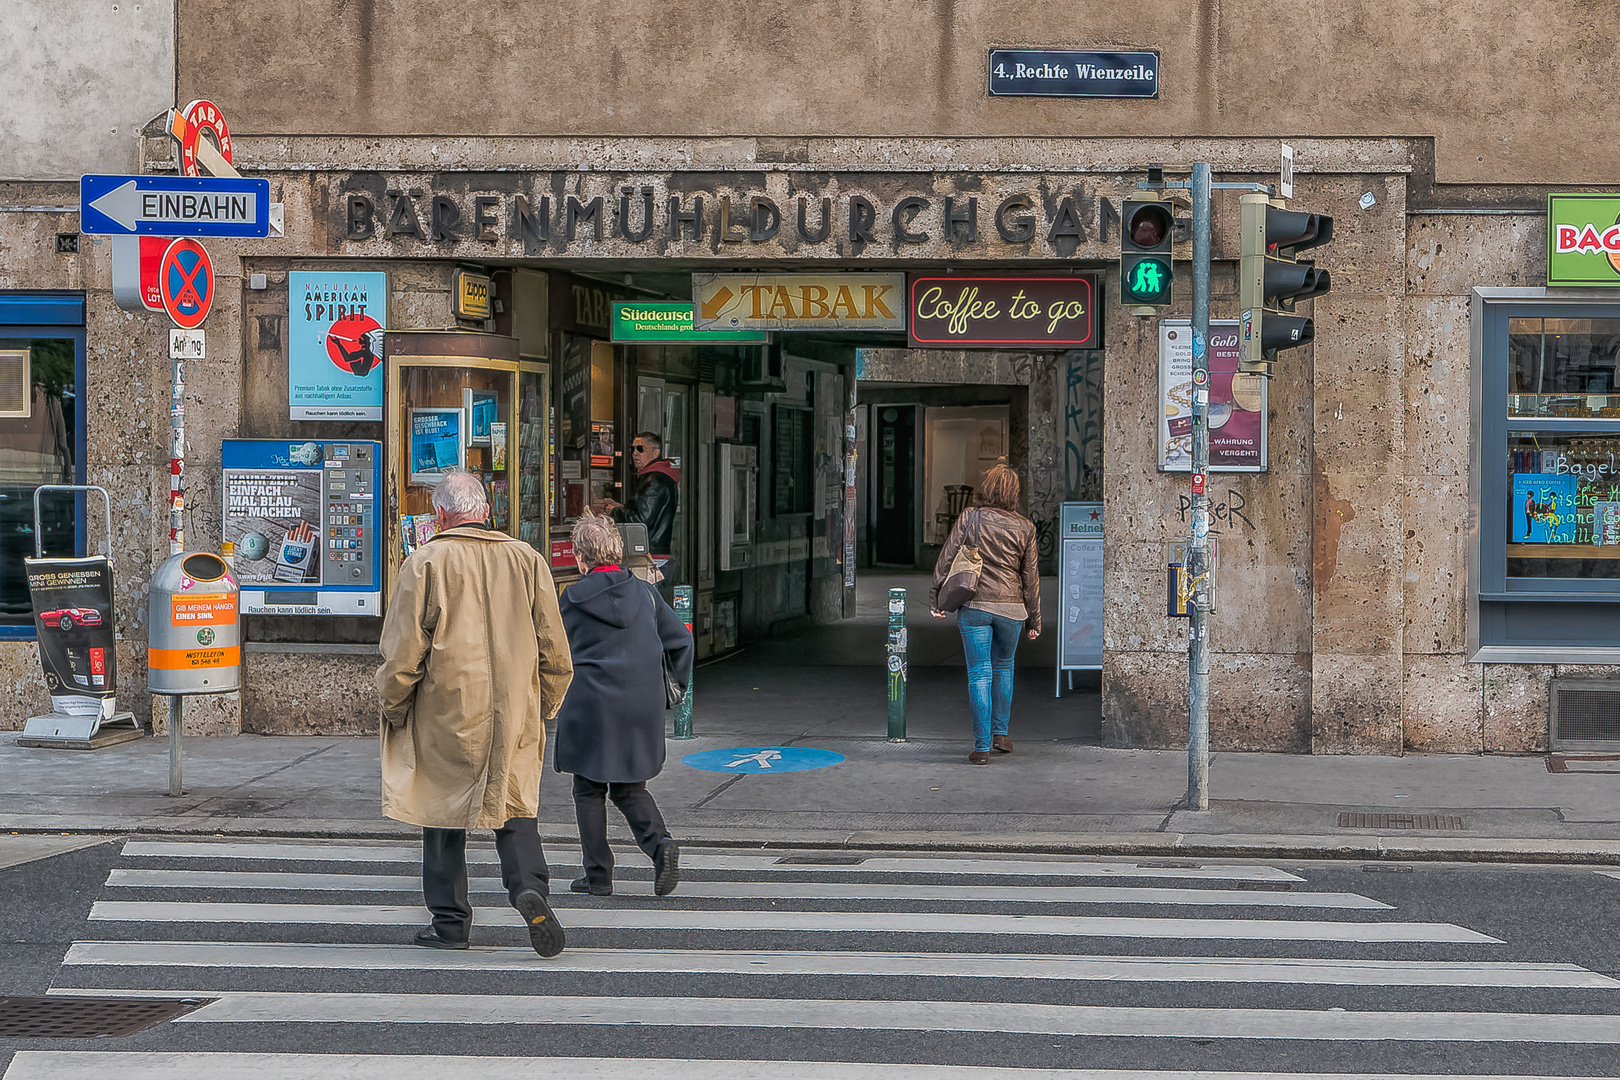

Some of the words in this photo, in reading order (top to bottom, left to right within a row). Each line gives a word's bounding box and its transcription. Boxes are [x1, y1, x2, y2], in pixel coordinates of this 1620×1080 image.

[1075, 63, 1154, 80] Wienzeile
[189, 105, 231, 154] TABAK
[141, 195, 247, 221] EINBAHN
[1559, 226, 1620, 250] BAG
[147, 294, 161, 303] LOT
[304, 292, 367, 302] AMERICAN
[740, 284, 897, 319] TABAK
[572, 284, 624, 328] TABA
[917, 286, 1001, 334] Coffee
[1008, 289, 1042, 319] to
[1047, 300, 1086, 334] go
[304, 303, 367, 321] SPIRIT
[635, 323, 679, 331] Deutschlands
[1210, 334, 1238, 347] Gold
[414, 415, 438, 423] GROSSER
[414, 421, 447, 429] GESCHMACK
[229, 485, 281, 496] EINFACH
[229, 496, 257, 506] MAL
[260, 496, 293, 507] BLAU
[229, 506, 245, 517] ZU
[248, 507, 301, 518] MACHEN
[1070, 523, 1104, 533] Heinek
[28, 573, 56, 581] GROSS
[57, 571, 101, 579] GENIESSEN
[46, 578, 87, 586] GEWINNEN
[175, 604, 186, 612] GIB
[187, 603, 212, 611] MEINEM
[248, 605, 276, 614] Rauchen
[277, 606, 293, 614] kann
[294, 606, 316, 615] tödlich
[185, 650, 225, 659] MISTTELEFON
